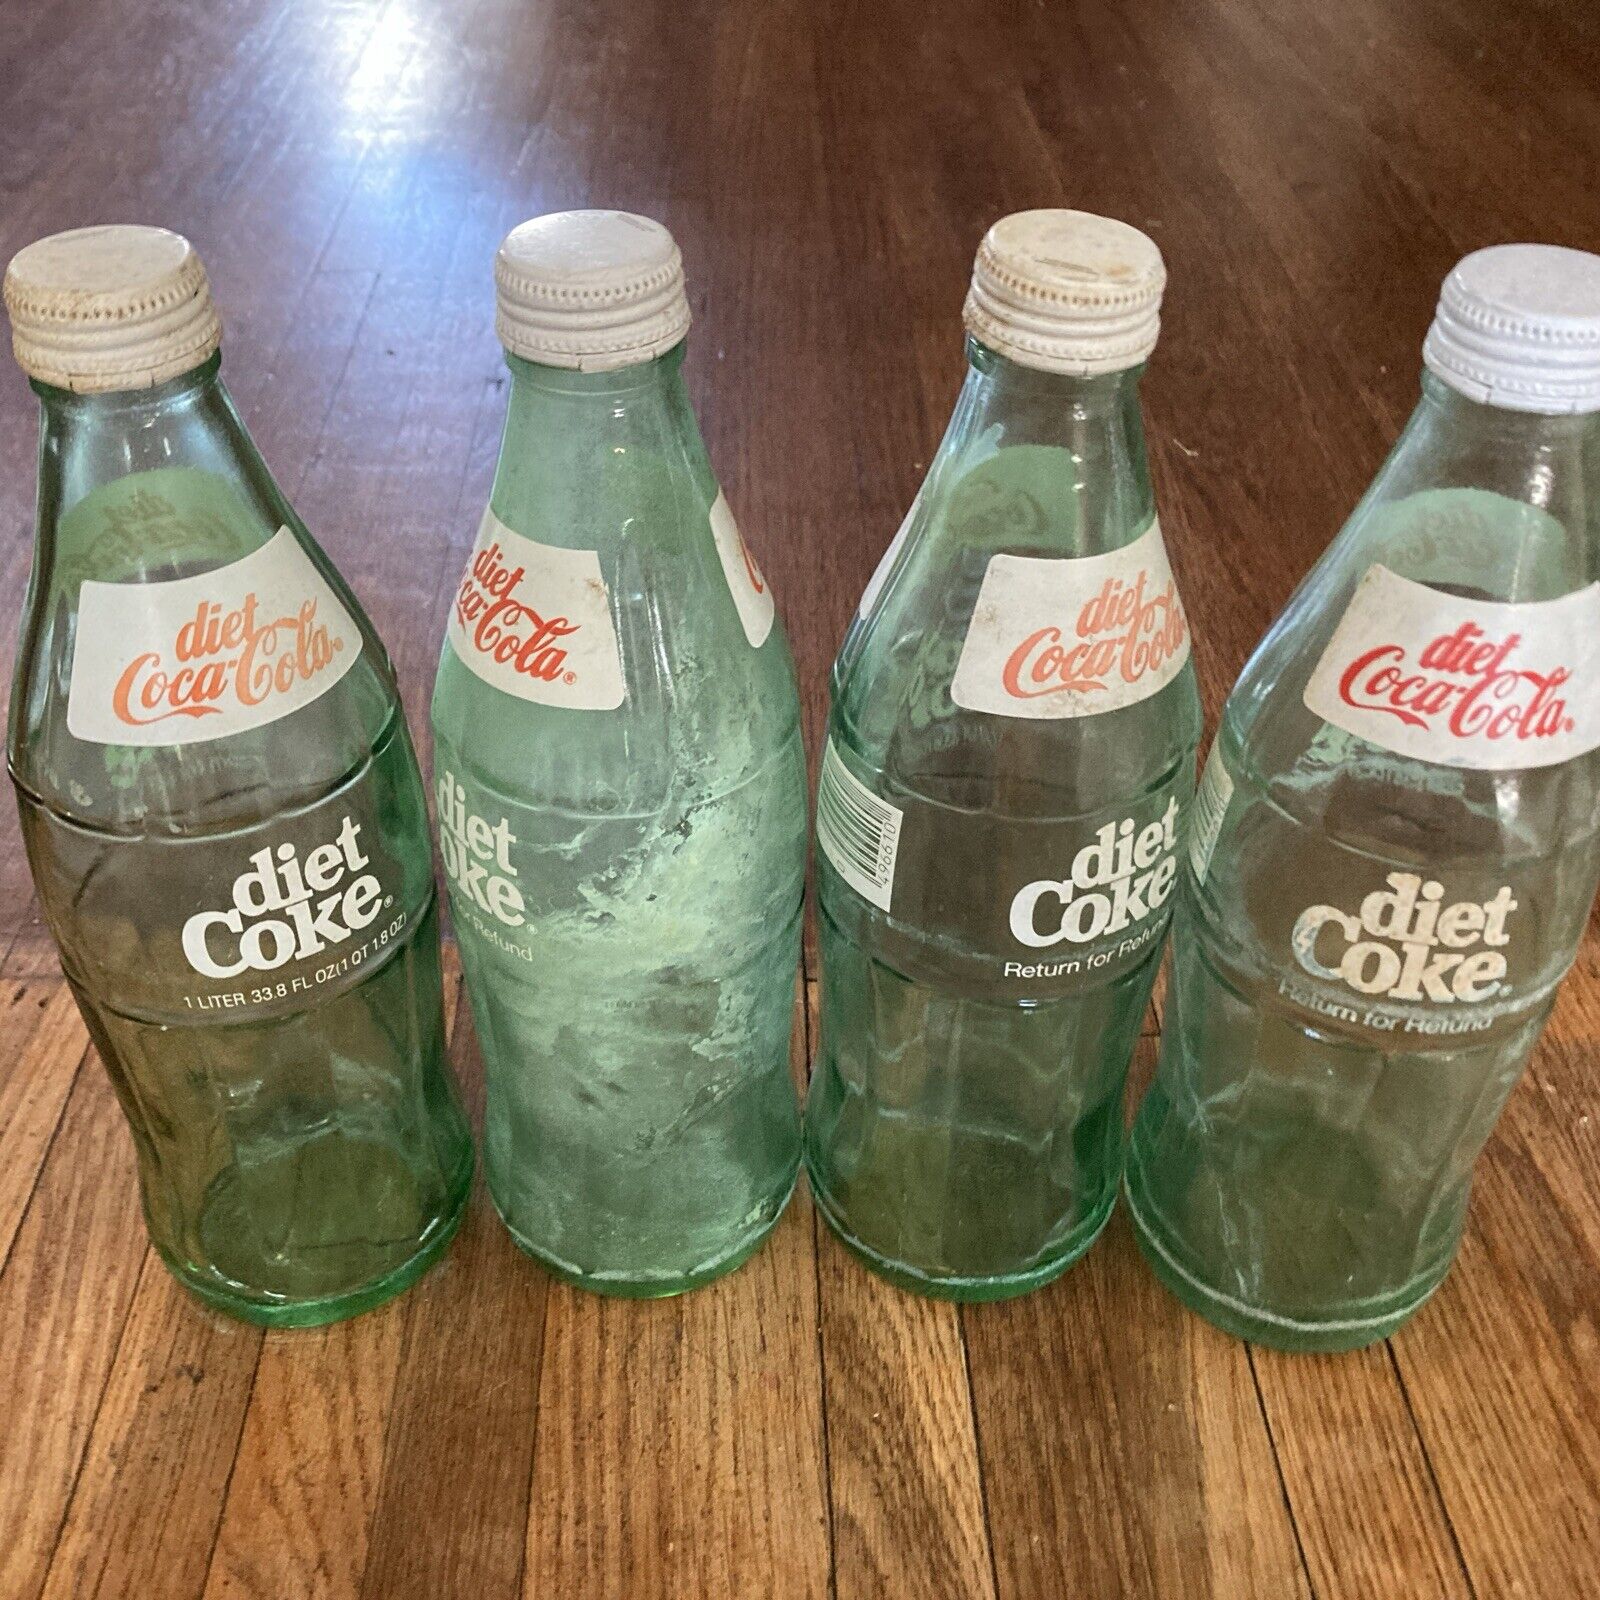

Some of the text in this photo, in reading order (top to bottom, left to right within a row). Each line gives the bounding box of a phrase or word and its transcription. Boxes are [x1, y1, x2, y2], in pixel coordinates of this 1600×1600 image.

[472, 542, 526, 600] diet
[1076, 570, 1148, 638] diet
[175, 592, 259, 662] diet
[1419, 621, 1522, 676] diet
[438, 770, 518, 877] diet
[1071, 795, 1180, 889] diet
[232, 816, 370, 917] diet
[439, 823, 526, 927] oke
[1009, 854, 1177, 948] Coke
[181, 874, 383, 979] Coke
[1360, 872, 1518, 948] diet
[197, 992, 247, 1010] LITER
[252, 983, 288, 1004] 33.8
[291, 975, 314, 994] FL
[1003, 960, 1081, 979] Return
[1086, 949, 1116, 971] for
[1291, 904, 1508, 1003] Coke
